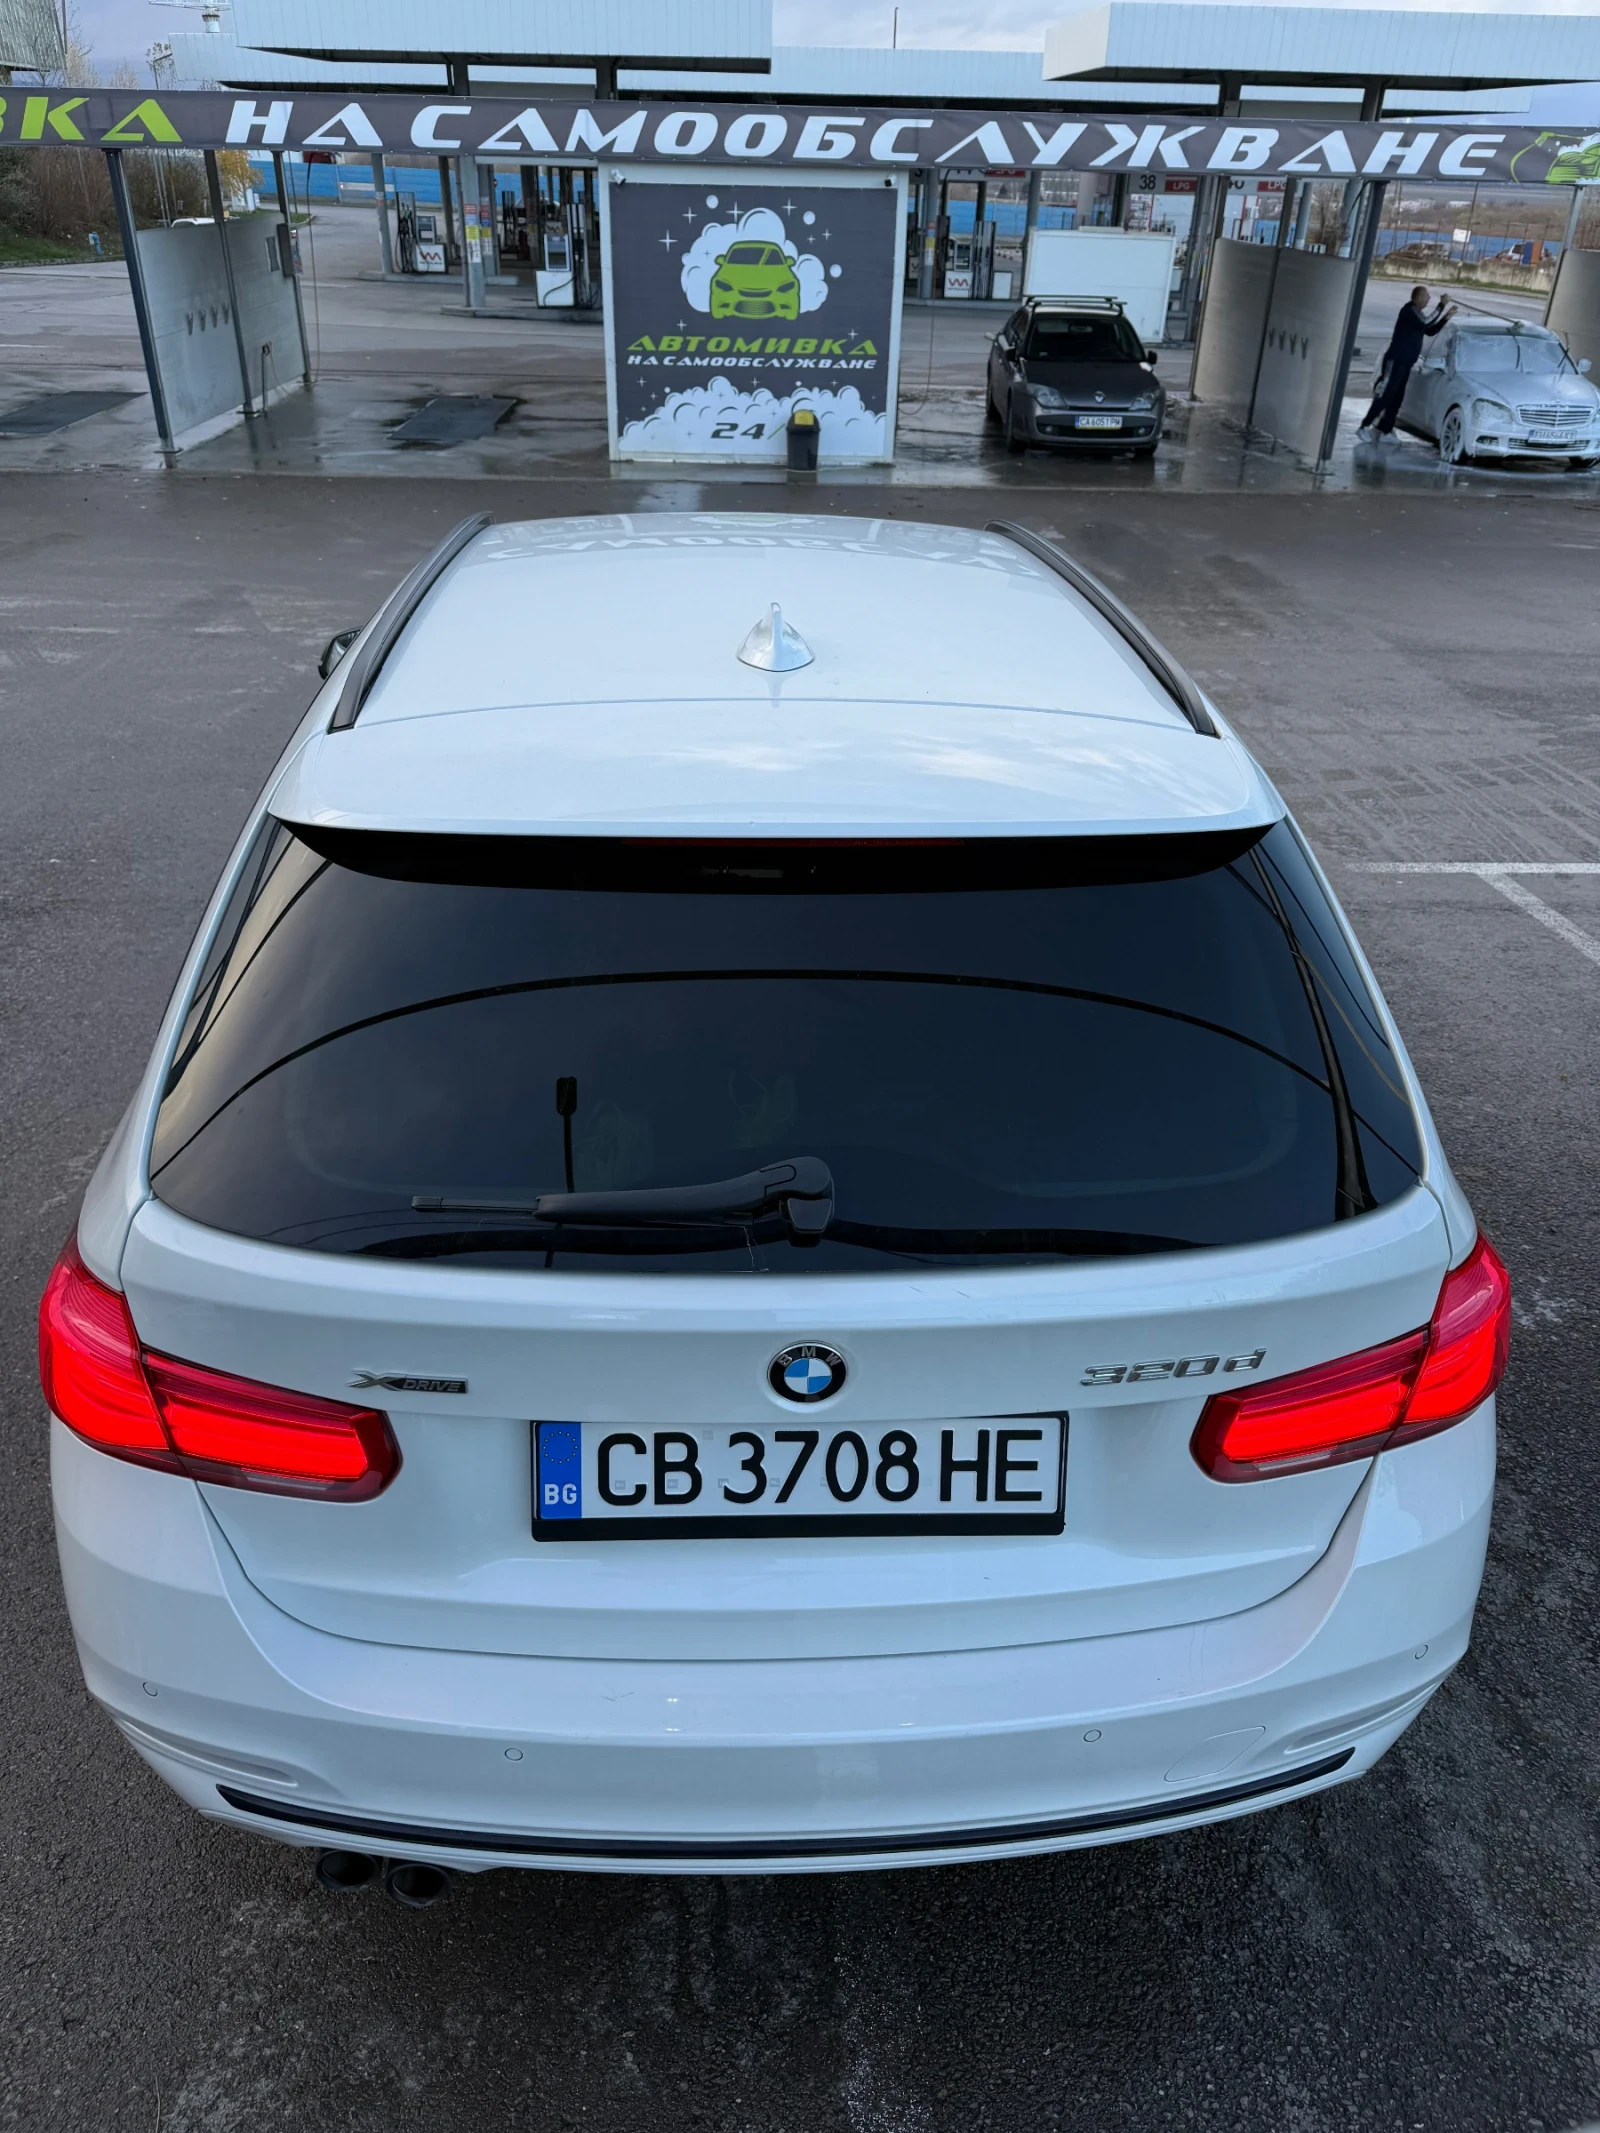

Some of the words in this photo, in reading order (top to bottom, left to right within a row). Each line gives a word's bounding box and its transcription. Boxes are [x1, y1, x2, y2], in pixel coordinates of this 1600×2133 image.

[0, 96, 183, 143] КА
[225, 100, 383, 147] НА
[410, 104, 1506, 176] САМООБСЛУЖВАНЕ
[1139, 174, 1156, 190] 38
[1172, 181, 1190, 190] LPG
[626, 335, 878, 355] АВТОМИВКА
[627, 355, 659, 366] НА
[663, 356, 878, 369] САМООБСЛУЖВАНЕ
[711, 421, 786, 441] 24/
[777, 1346, 842, 1368] BMW
[1080, 1347, 1267, 1386] 320d
[598, 1432, 702, 1506] CB
[723, 1429, 919, 1504] 3708
[939, 1428, 1043, 1502] HE
[544, 1483, 577, 1505] BG
